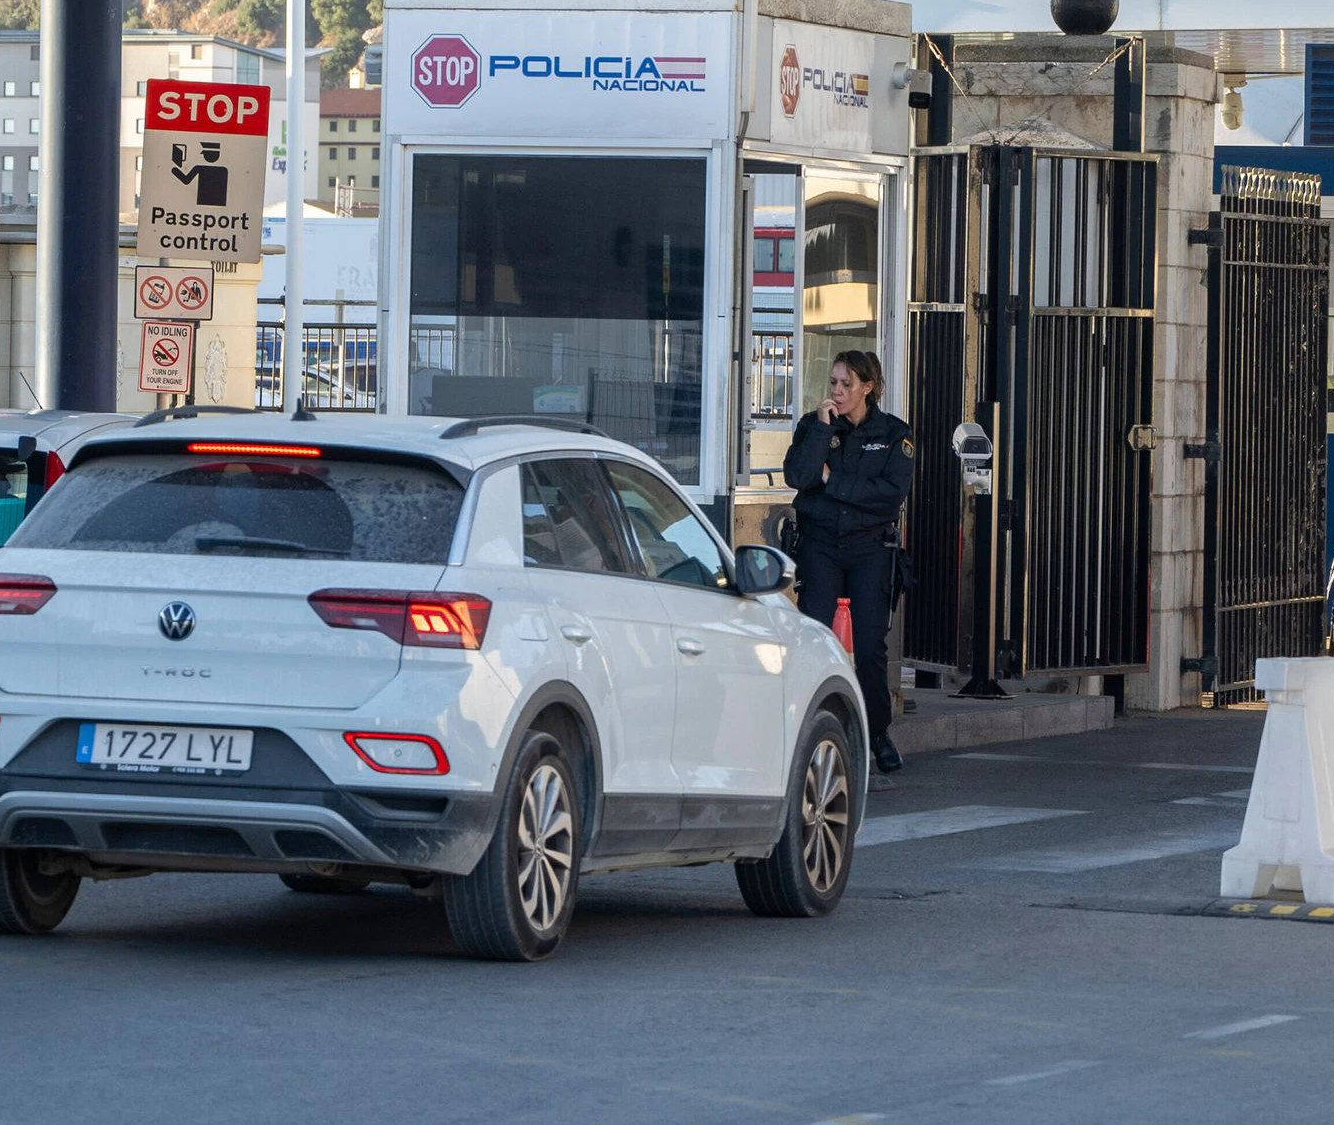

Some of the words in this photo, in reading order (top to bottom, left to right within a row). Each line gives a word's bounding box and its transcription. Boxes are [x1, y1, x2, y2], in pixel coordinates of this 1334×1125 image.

[419, 55, 474, 86] STOP
[593, 80, 706, 92] NACIONAL
[781, 65, 799, 96] STOP
[157, 91, 260, 124] STOP
[834, 94, 869, 108] NACIONAL
[151, 206, 249, 232] Passport
[160, 233, 238, 252] control
[211, 260, 239, 274] TOILET
[147, 326, 160, 336] NO
[161, 327, 188, 338] IDLING
[152, 368, 167, 376] TURN
[147, 376, 162, 385] YOUR
[162, 377, 183, 386] ENGINE
[140, 665, 212, 678] T-ROC
[106, 730, 177, 760] 1727
[186, 733, 243, 764] LYL
